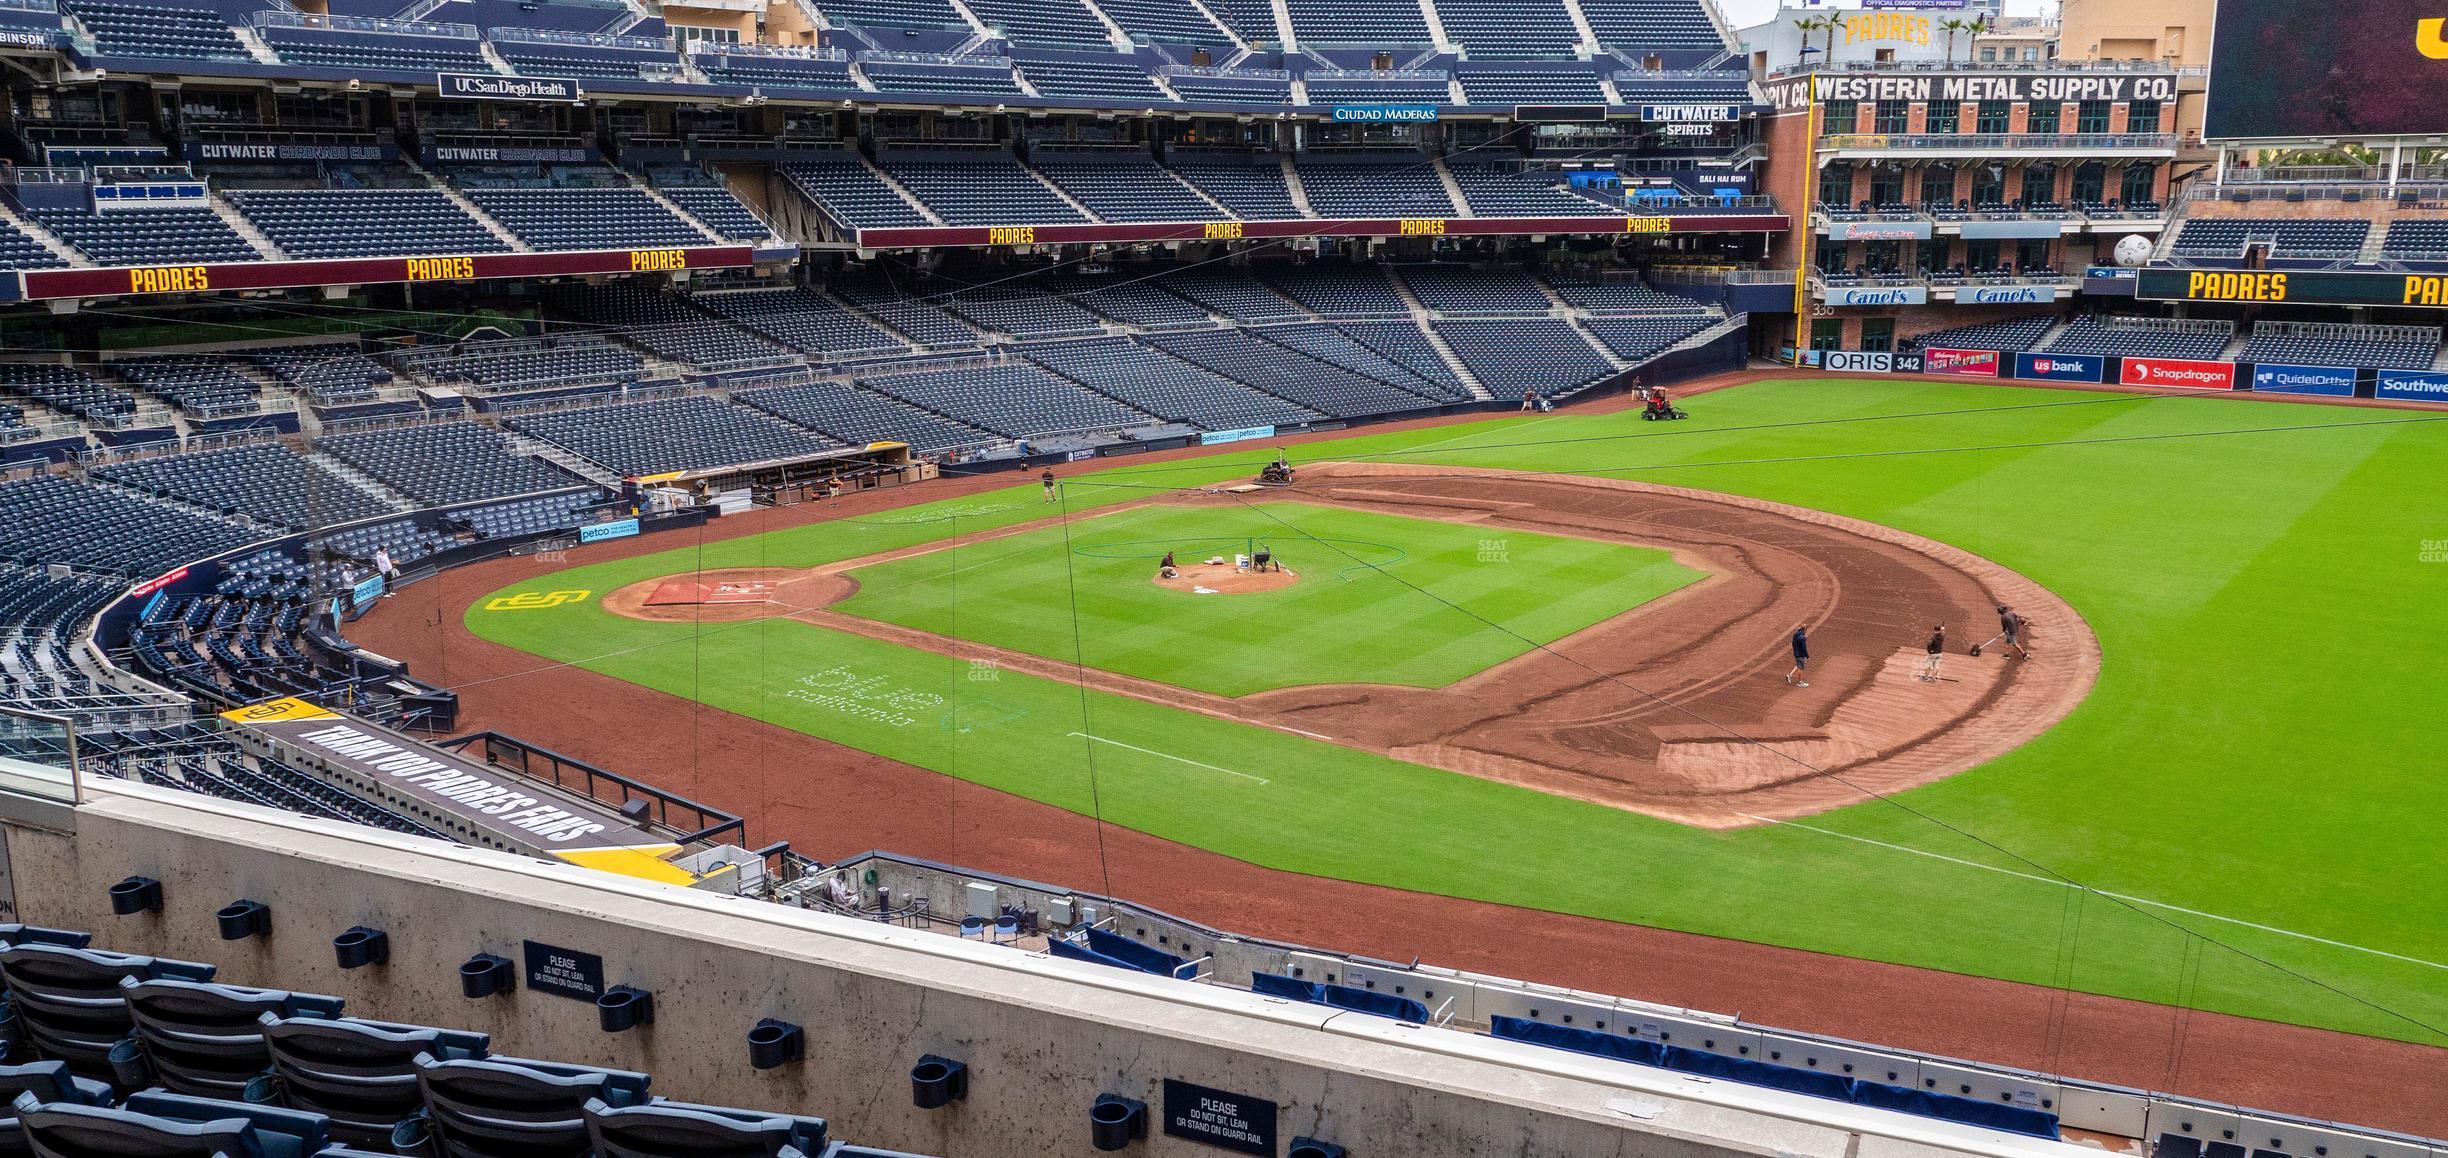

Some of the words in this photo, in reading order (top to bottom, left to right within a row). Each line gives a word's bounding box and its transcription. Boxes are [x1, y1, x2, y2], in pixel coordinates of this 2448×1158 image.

[1845, 11, 1929, 46] PADRES
[454, 78, 475, 92] UC
[475, 79, 498, 93] San
[498, 80, 530, 97] Diego
[530, 81, 566, 96] Health
[1815, 77, 1930, 100] WESTERN
[1943, 77, 2023, 100] METAL
[2031, 78, 2123, 100] SUPPLY
[2133, 78, 2174, 100] CO.
[1336, 109, 1382, 120] CIUDAD
[1384, 109, 1435, 120] MADERAS
[1653, 106, 1729, 121] CUTWATER
[1666, 125, 1713, 136] SPIRITS
[202, 144, 276, 158] CUTWATER
[437, 147, 497, 160] CUTWATER
[1699, 175, 1716, 183] BALI
[1716, 175, 1729, 183] HAI
[1730, 175, 1747, 183] RUM
[1204, 222, 1242, 239] PADRES
[1399, 219, 1445, 235] PADRES
[1627, 218, 1671, 232] PADRES
[989, 227, 1034, 245] PADRES
[407, 256, 474, 280] PADRES
[630, 249, 686, 271] PADRES
[130, 266, 208, 292] PADRES
[2188, 271, 2288, 301] PADRES
[1845, 288, 1908, 305] Canel's
[1975, 287, 2037, 303] Canel's
[1828, 353, 1890, 370] ORIS
[1897, 357, 1920, 371] 342
[2035, 360, 2050, 371] us
[2052, 360, 2084, 372] bank
[2152, 367, 2226, 383] Snapdragon
[2277, 373, 2350, 387] QuidelOrtho
[1203, 434, 1220, 443] petco
[582, 528, 610, 541] petco
[298, 725, 405, 760] THANK
[363, 750, 449, 777] YOU
[406, 768, 538, 815] PADRES
[497, 805, 605, 842] FANS
[549, 955, 576, 970] PLEASE
[543, 965, 552, 974] DO
[551, 967, 562, 976] NOT
[562, 969, 571, 979] SIT,
[571, 971, 585, 982] LEAN
[534, 972, 543, 981] OR
[542, 974, 559, 985] STAND
[558, 977, 567, 986] ON
[566, 980, 584, 990] GUARD
[584, 983, 596, 993] RAIL
[1201, 1097, 1238, 1117] PLEASE
[1190, 1108, 1200, 1119] DO
[1201, 1111, 1216, 1121] NOT
[1216, 1114, 1229, 1127] SIT,
[1230, 1118, 1248, 1130] LEAN
[1176, 1116, 1186, 1127] OR
[1187, 1119, 1210, 1132] STAND
[1210, 1125, 1221, 1135] ON
[1222, 1127, 1246, 1141] GUARD
[1247, 1133, 1263, 1145] RAIL
